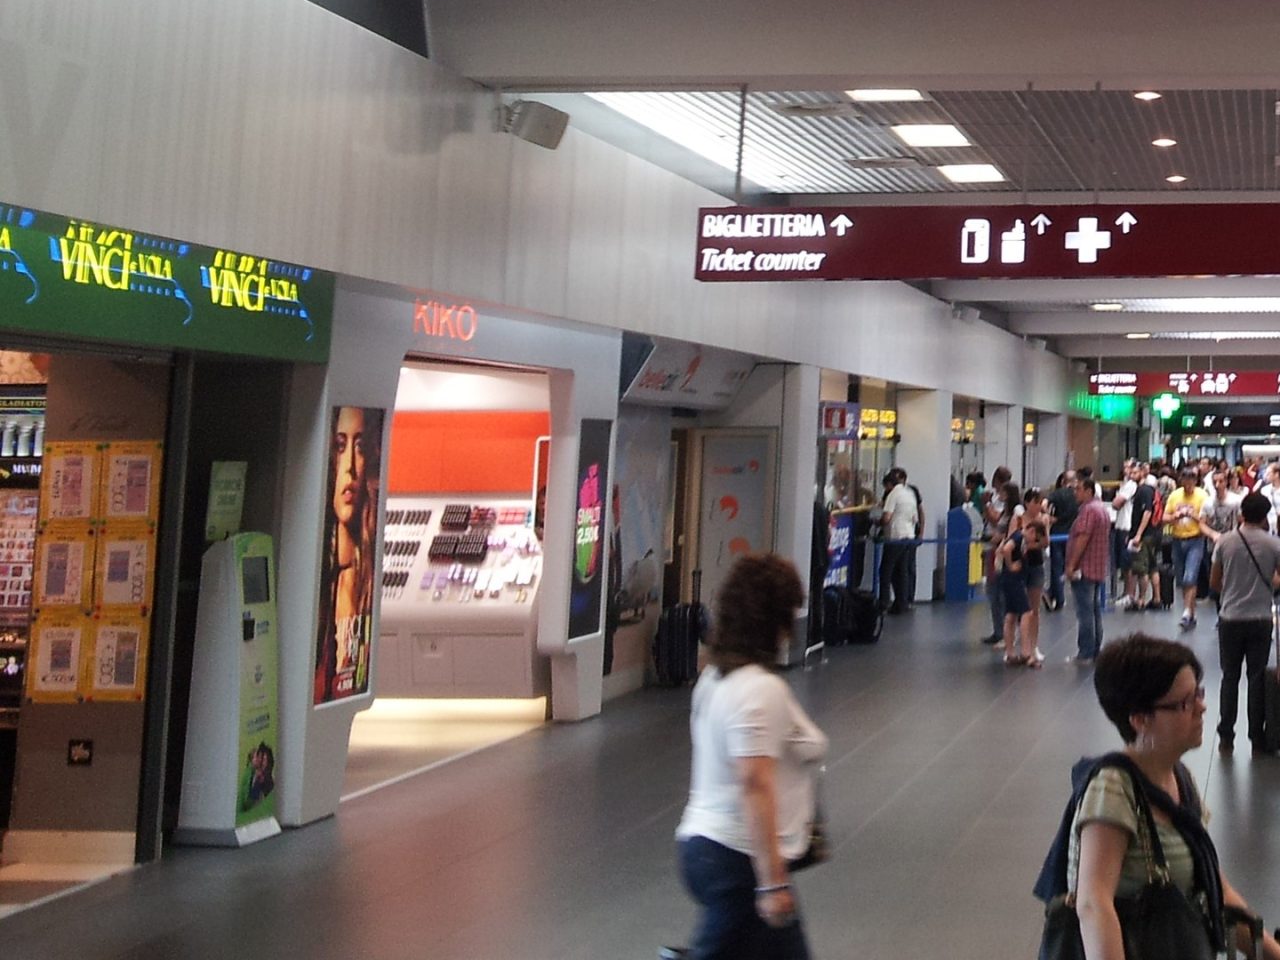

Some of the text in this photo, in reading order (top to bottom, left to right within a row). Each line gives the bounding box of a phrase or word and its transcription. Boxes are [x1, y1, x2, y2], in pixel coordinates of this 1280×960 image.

[702, 213, 826, 237] BIGLIETTERIA
[59, 237, 131, 290] VINCI
[701, 247, 826, 271] Ticket counter
[208, 266, 265, 312] VINCI
[413, 299, 478, 341] KIKO
